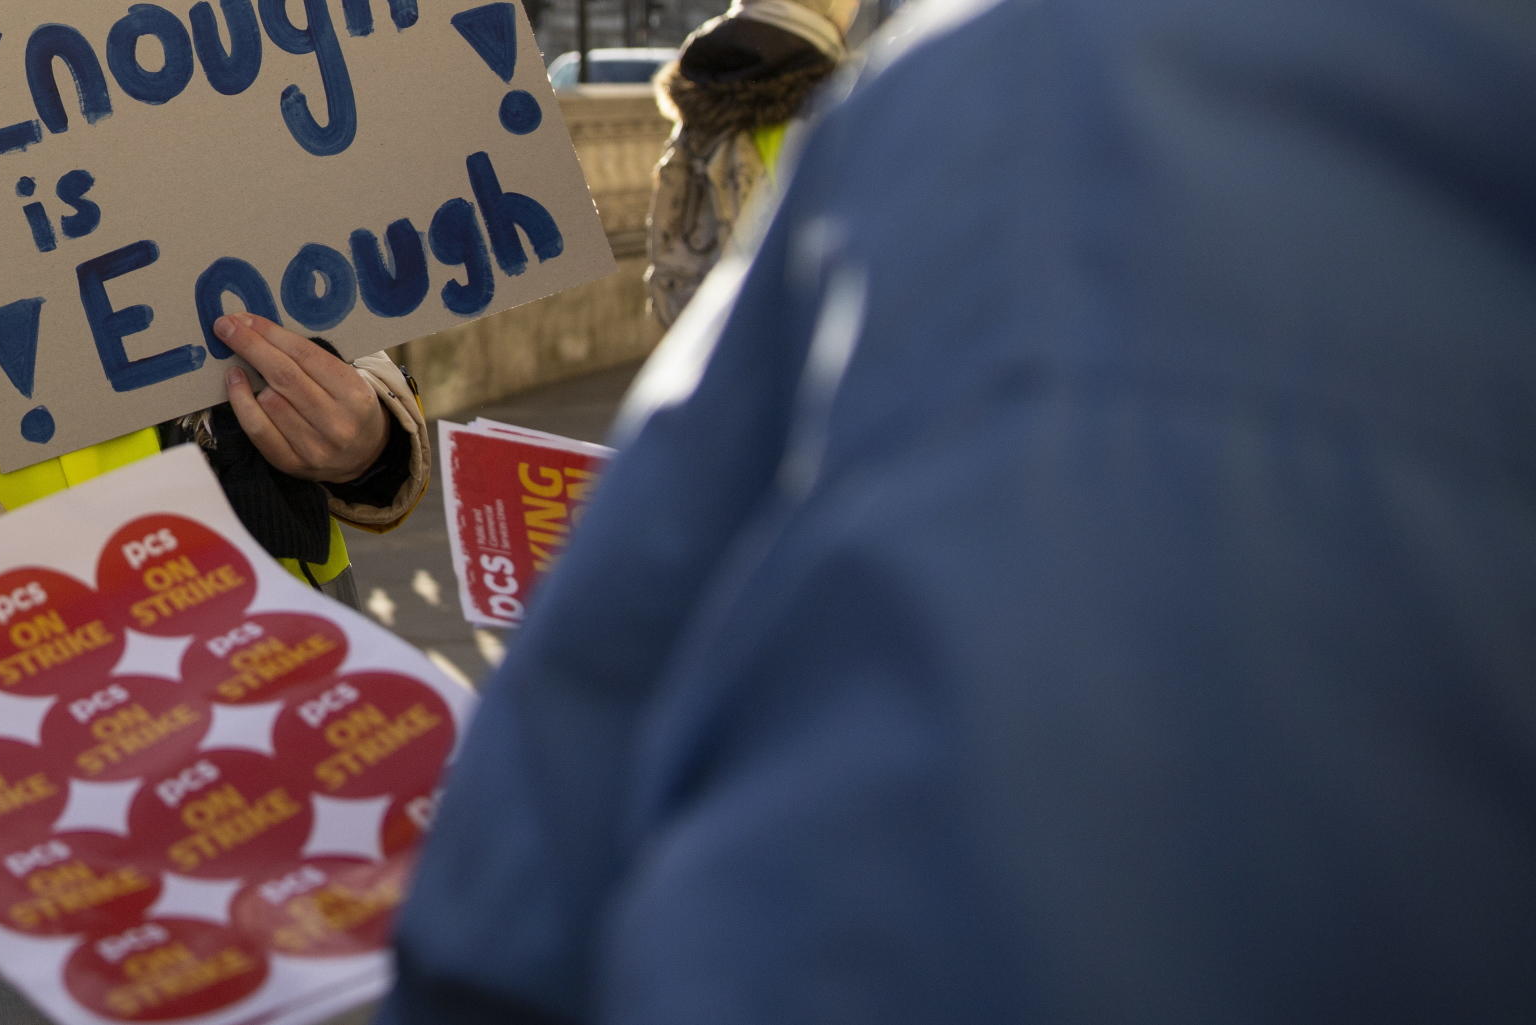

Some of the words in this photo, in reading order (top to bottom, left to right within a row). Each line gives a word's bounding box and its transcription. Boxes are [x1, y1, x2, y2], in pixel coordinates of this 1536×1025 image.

[15, 169, 101, 252] is
[76, 150, 564, 393] Enough
[123, 530, 176, 567] pcs
[132, 565, 244, 624] STRIKE
[144, 556, 198, 590] ON
[11, 610, 64, 646] ON
[300, 684, 358, 724] pcs
[327, 704, 386, 746] ON
[317, 704, 440, 788] STRIKE
[157, 762, 218, 806] pcs
[170, 789, 300, 870] STRIKE
[183, 785, 247, 830] ON
